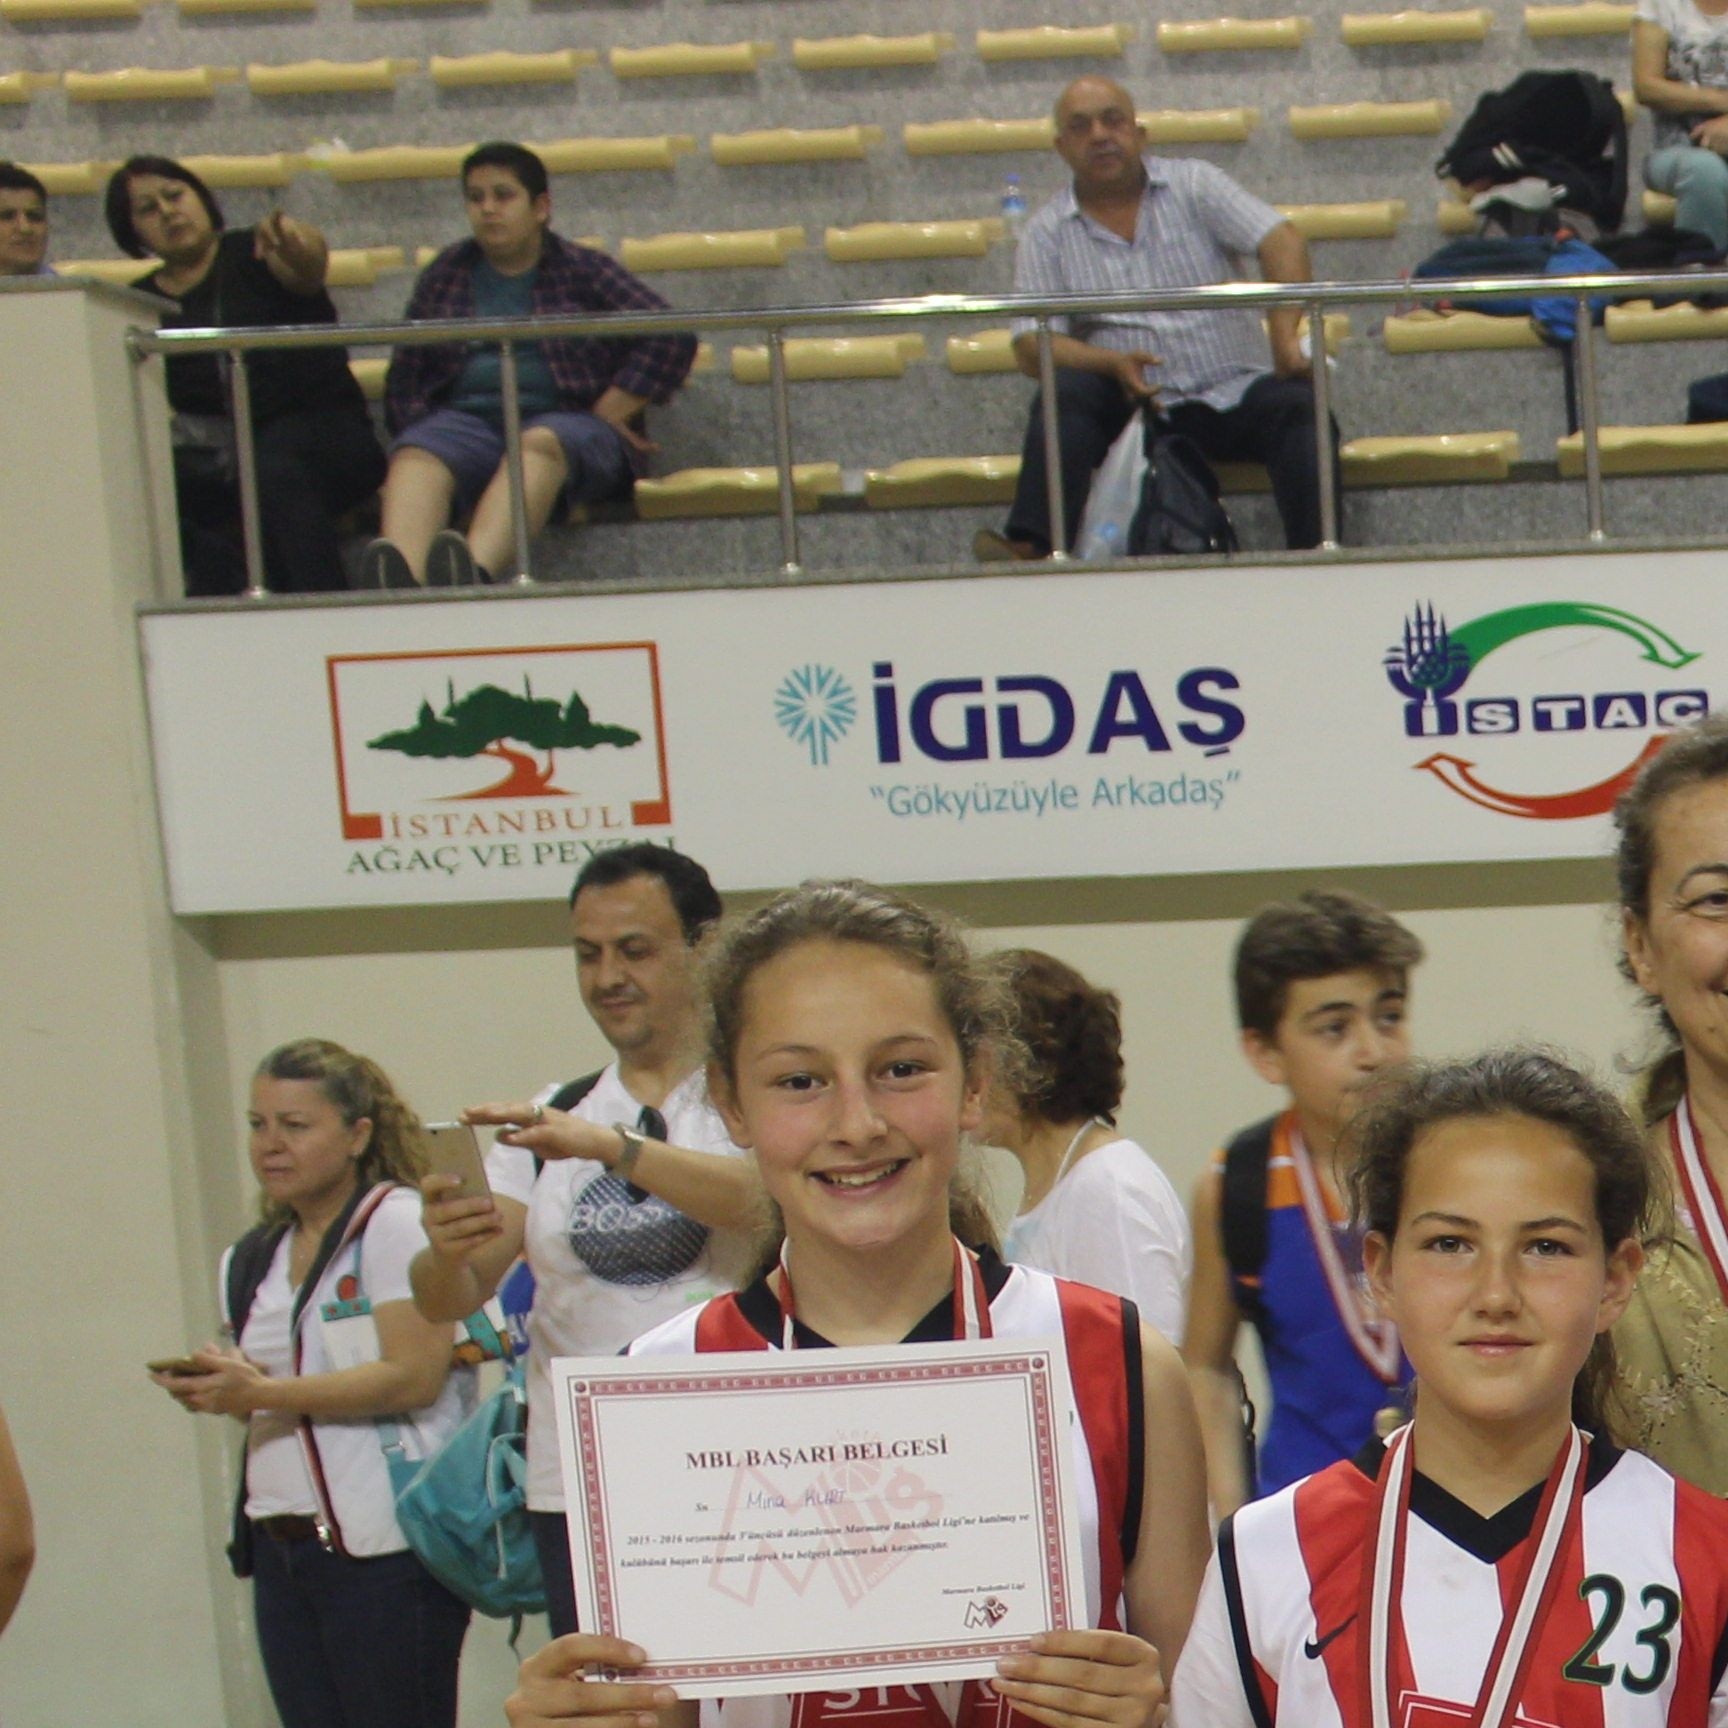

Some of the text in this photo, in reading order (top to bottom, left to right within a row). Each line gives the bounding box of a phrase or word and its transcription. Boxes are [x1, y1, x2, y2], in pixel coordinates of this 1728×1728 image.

[872, 660, 1247, 764] İGDAŞ
[391, 805, 624, 839] İSTANBUL
[347, 844, 460, 875] AĞAÇ
[468, 842, 521, 868] VE
[686, 1433, 949, 1470] MBL BAŞARI BELGESİ
[1561, 1573, 1684, 1696] 23
